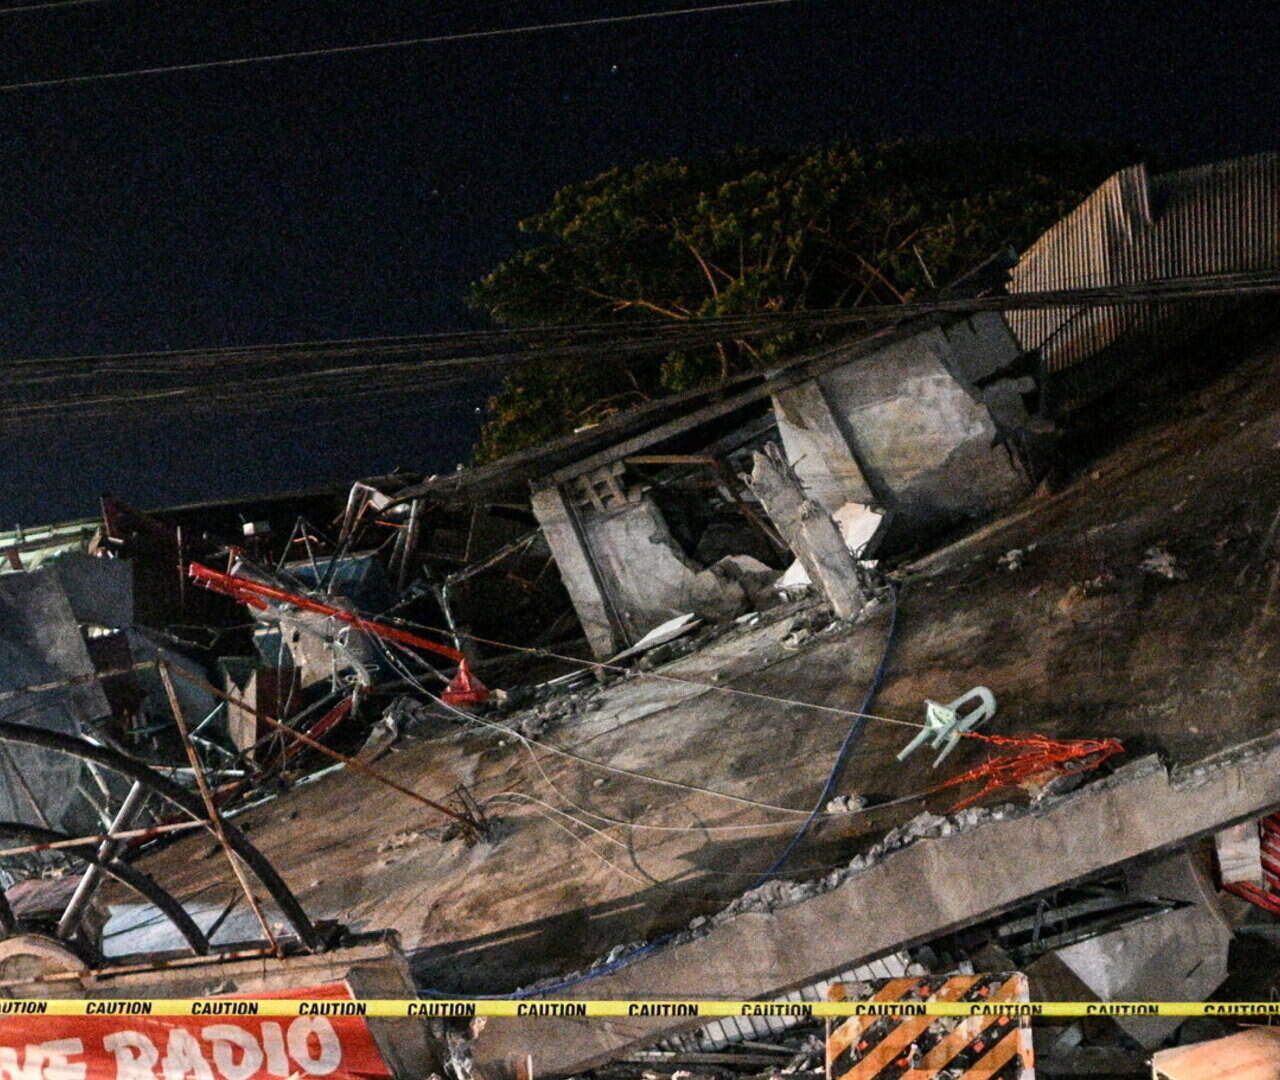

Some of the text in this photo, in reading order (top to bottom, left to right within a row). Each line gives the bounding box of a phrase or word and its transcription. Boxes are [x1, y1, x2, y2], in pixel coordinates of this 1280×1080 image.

[86, 1002, 151, 1014] CAUTION
[192, 1002, 258, 1015] CAUTION
[299, 1003, 366, 1015] CAUTION
[408, 1003, 475, 1016] CAUTION
[517, 1003, 586, 1016] CAUTION
[629, 1004, 698, 1016] CAUTION
[742, 1004, 812, 1016] CAUTION
[855, 1005, 927, 1015] CAUTION
[971, 1005, 1042, 1015] CAUTION
